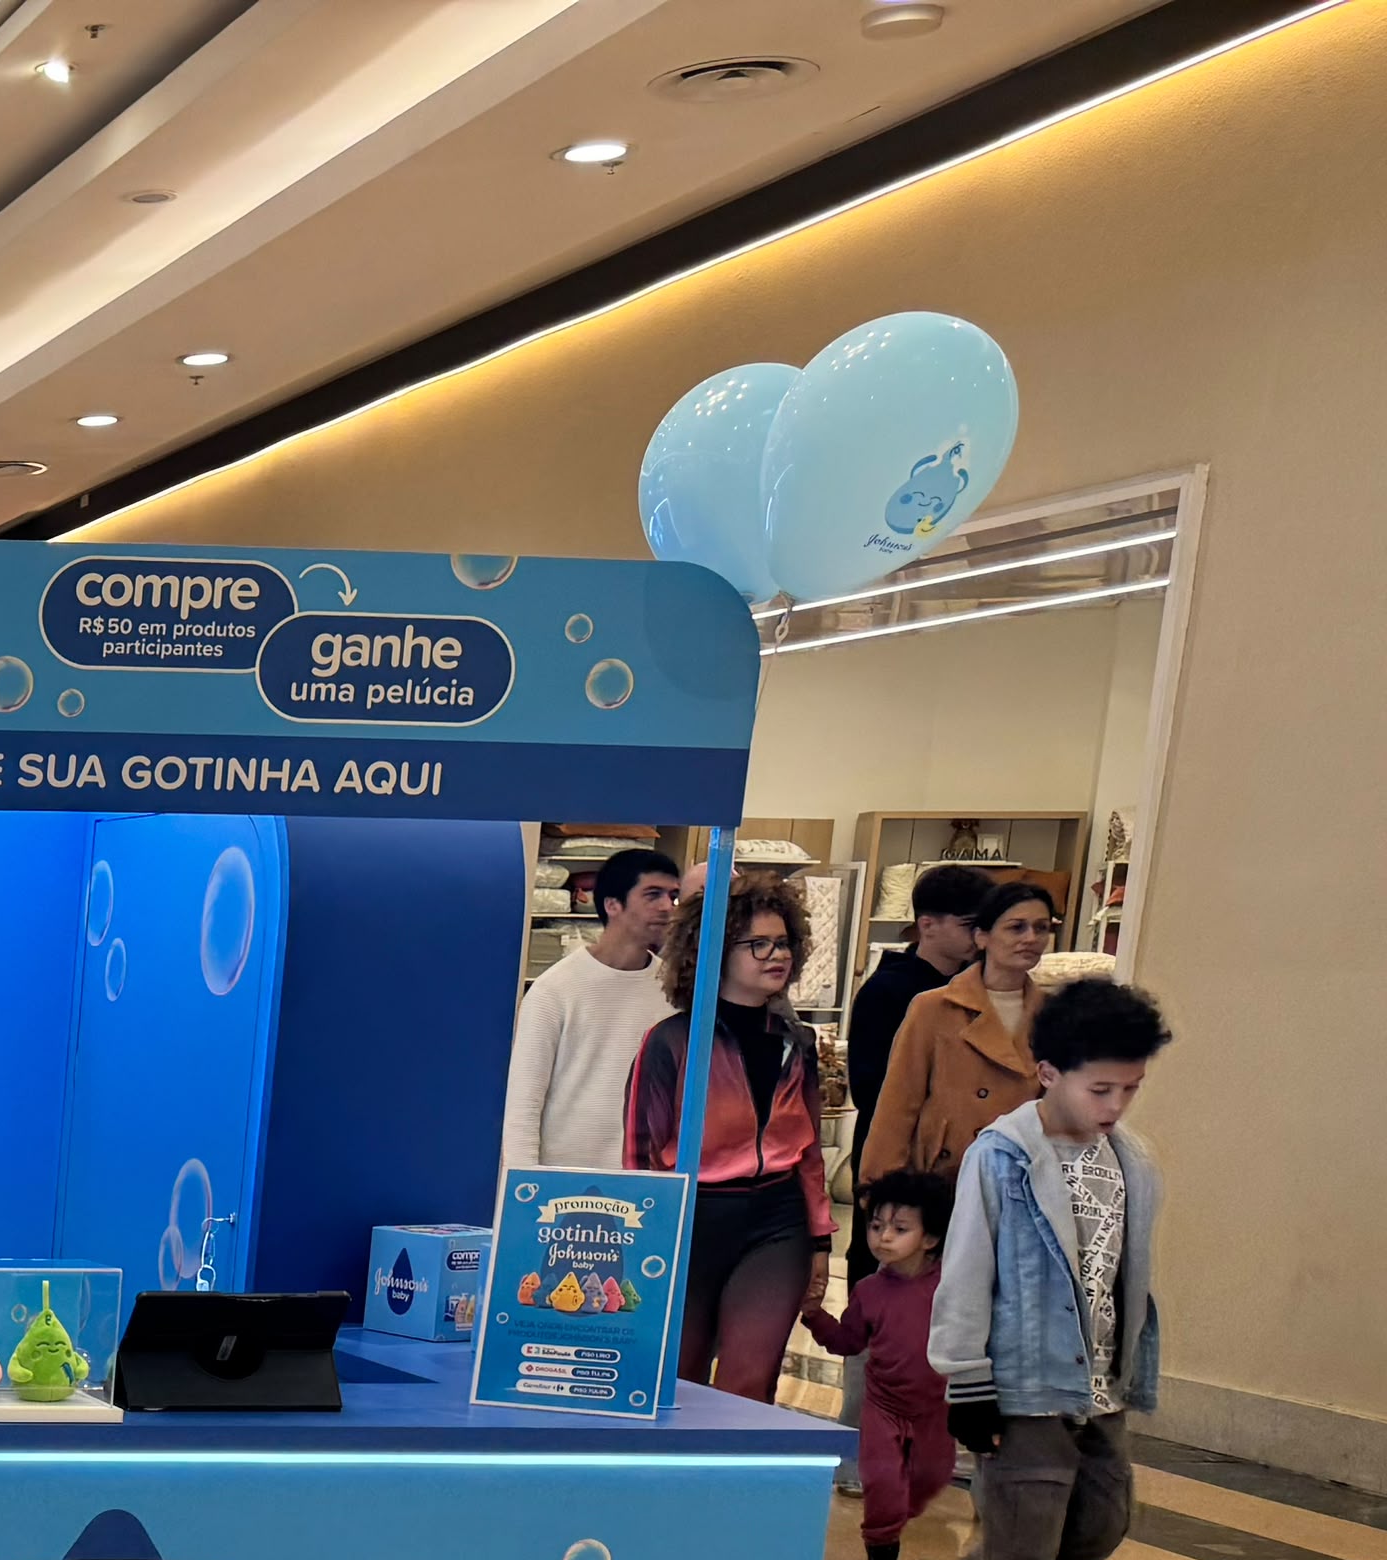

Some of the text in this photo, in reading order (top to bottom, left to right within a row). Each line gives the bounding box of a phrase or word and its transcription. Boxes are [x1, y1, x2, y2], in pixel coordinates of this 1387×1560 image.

[75, 571, 260, 620] compre
[138, 623, 167, 636] em
[173, 620, 256, 640] produtos
[103, 638, 224, 659] participantes
[311, 624, 463, 678] ganhe
[290, 678, 475, 709] uma pelúcia
[17, 753, 106, 788] SUA
[121, 755, 320, 793] GOTINHA
[333, 760, 443, 796] AQUI
[554, 1200, 629, 1214] promoção
[538, 1223, 635, 1245] gotinhas
[572, 1261, 594, 1270] baby
[392, 1290, 409, 1302] baby
